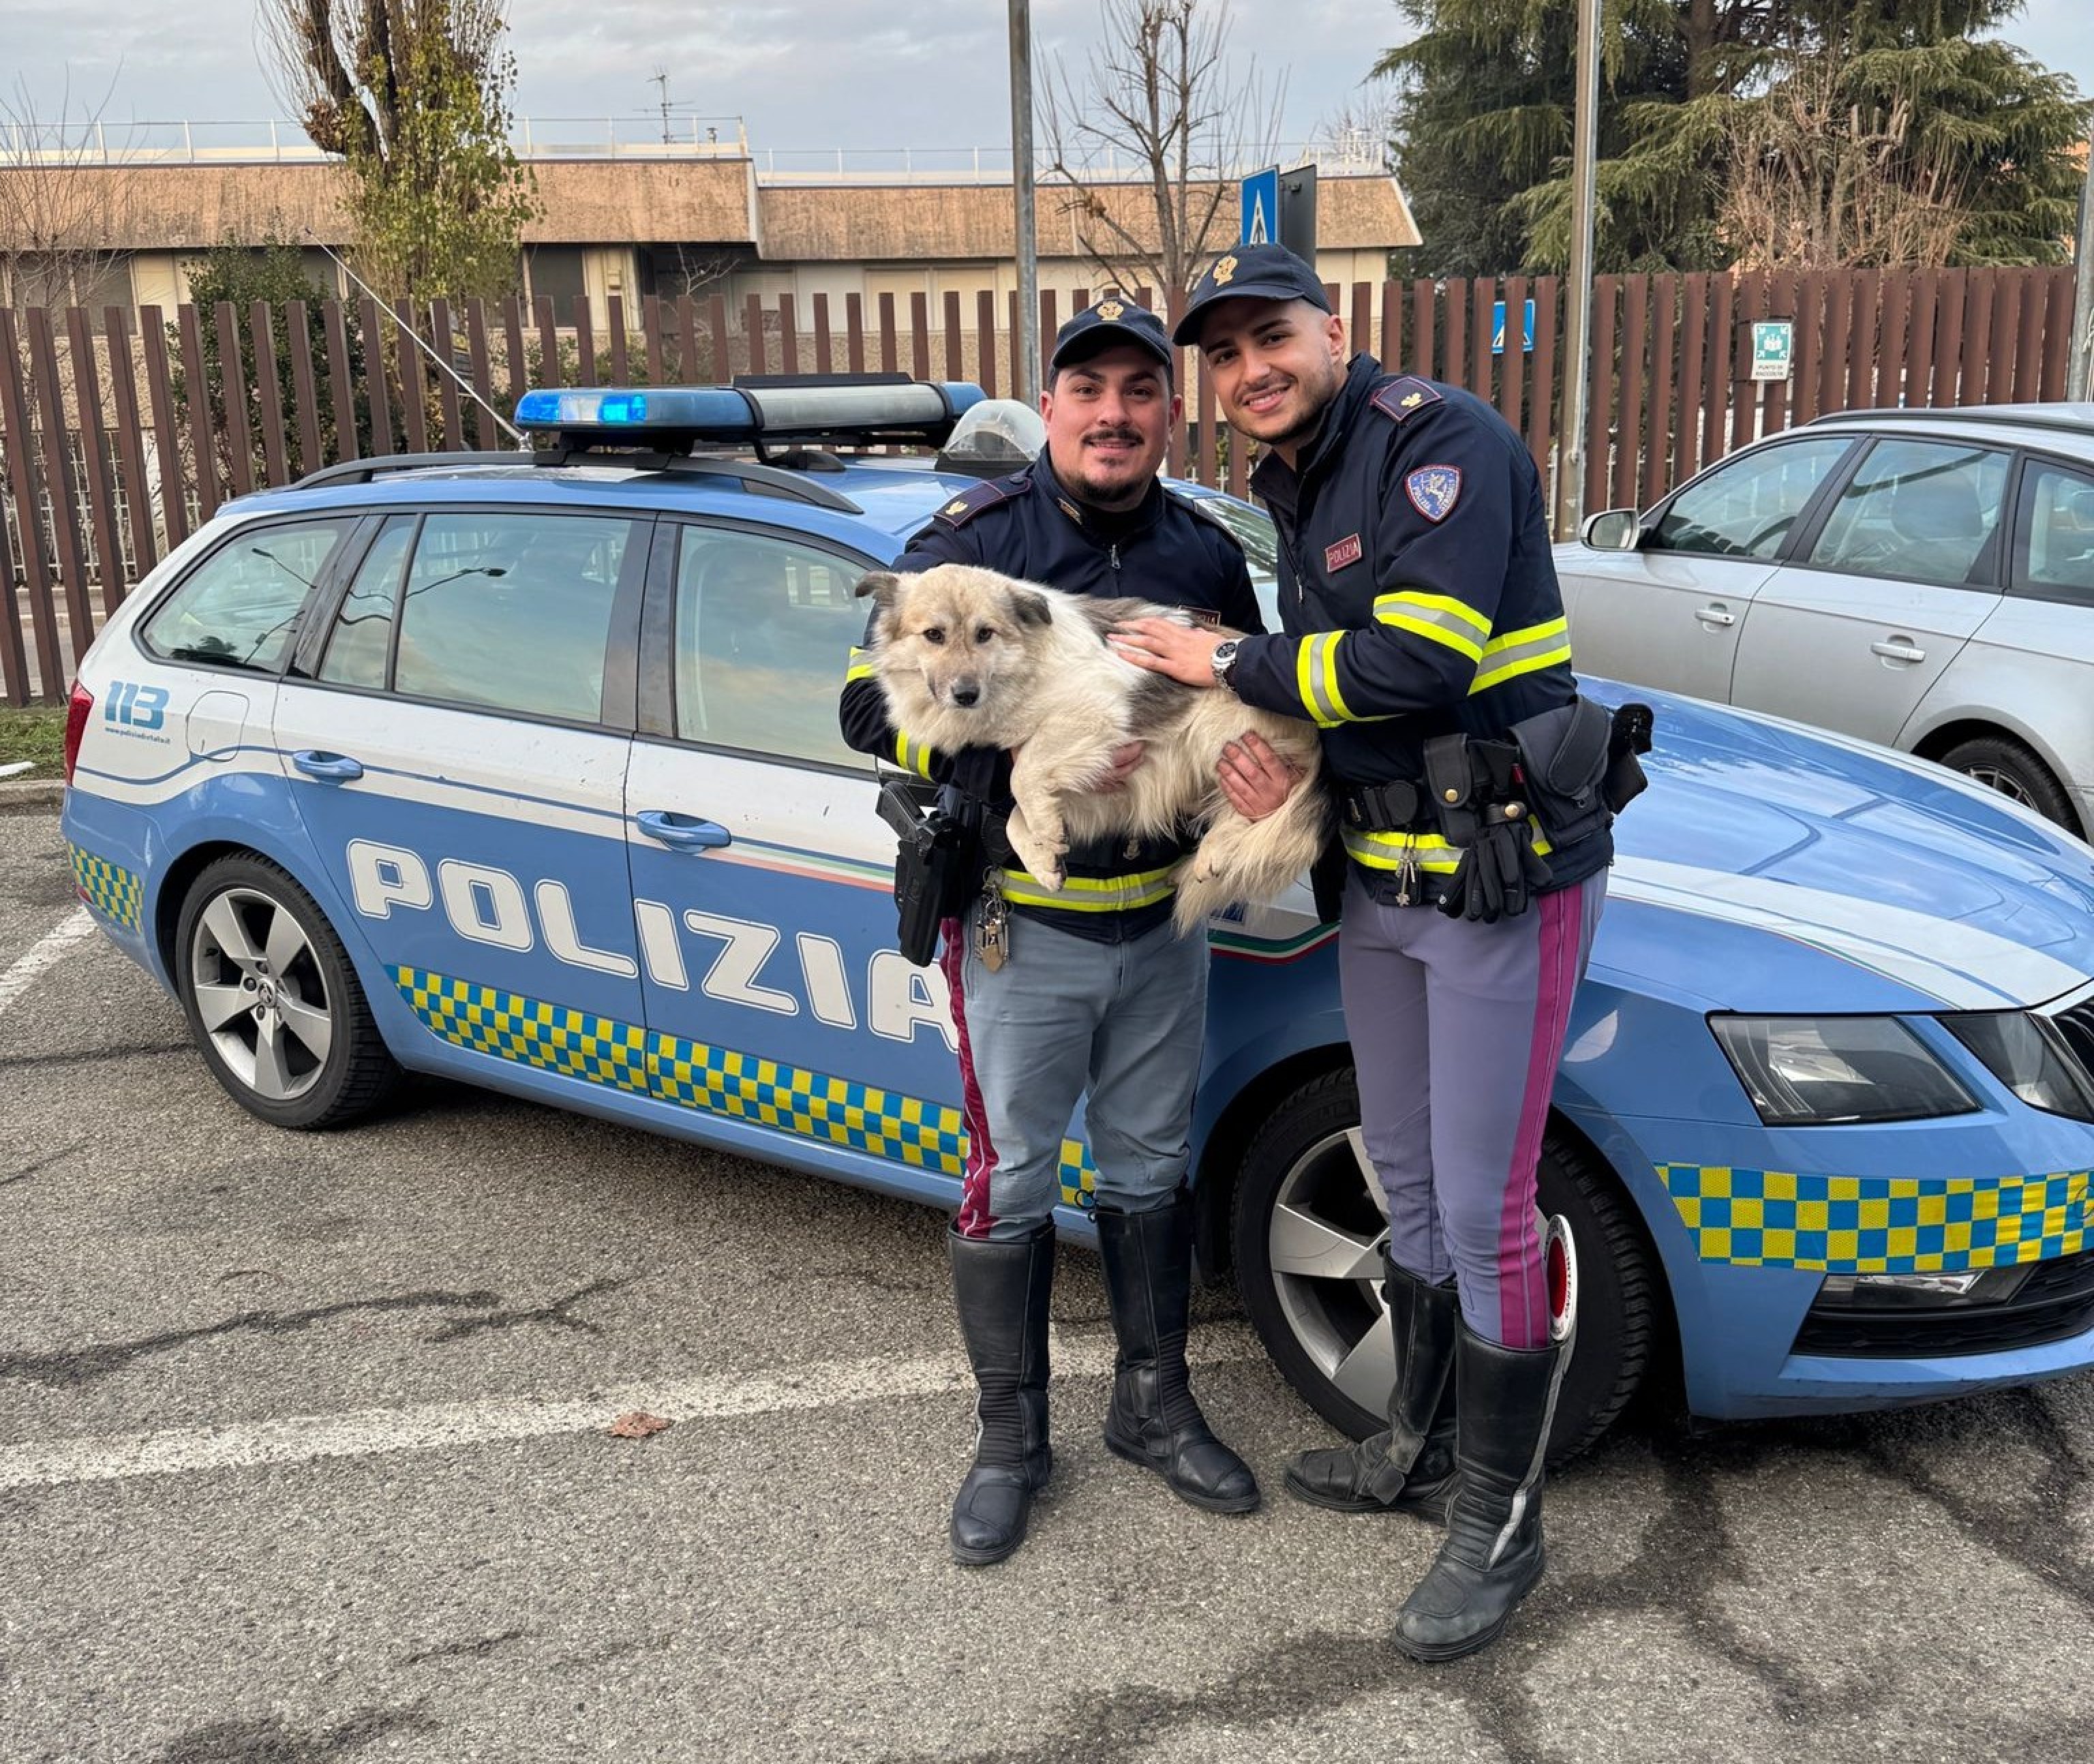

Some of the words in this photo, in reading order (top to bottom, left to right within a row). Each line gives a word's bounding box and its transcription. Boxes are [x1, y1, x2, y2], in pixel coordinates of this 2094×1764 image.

[1329, 541, 1359, 564] POLIZIA
[104, 680, 170, 730] 113
[346, 838, 959, 1054] POLIZIA
